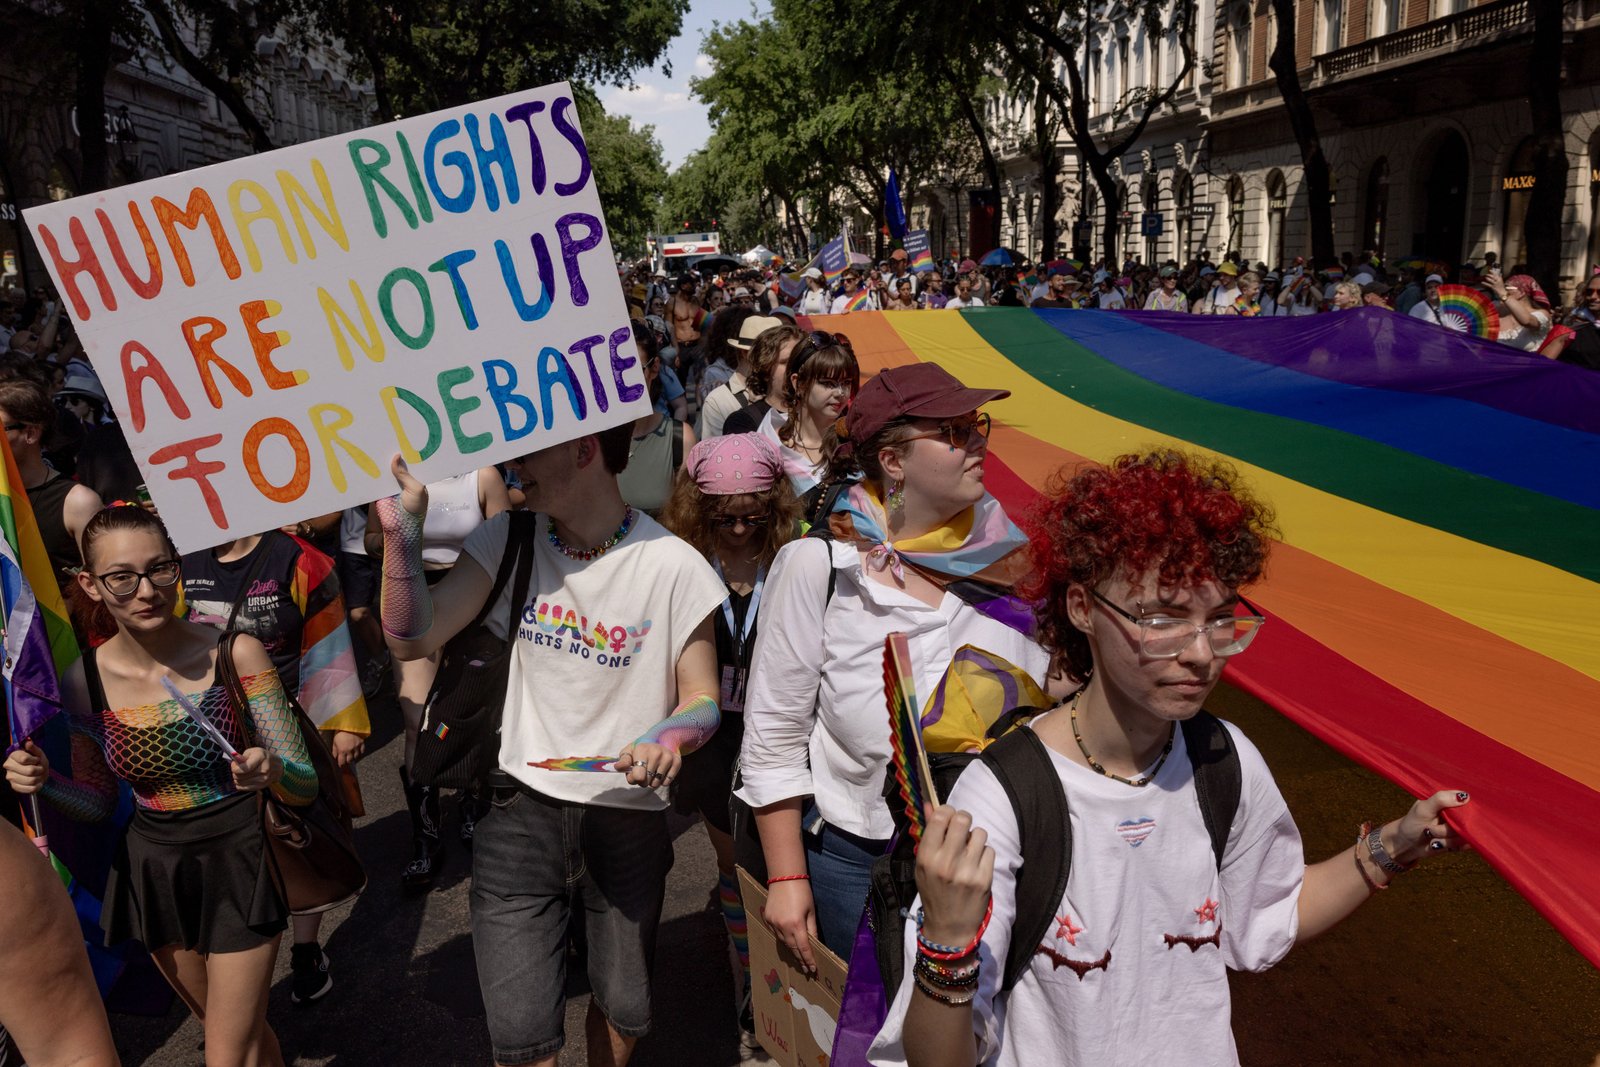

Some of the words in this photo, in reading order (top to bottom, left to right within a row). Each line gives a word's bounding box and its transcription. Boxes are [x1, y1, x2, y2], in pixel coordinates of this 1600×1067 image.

[38, 159, 349, 321] HUMAN
[349, 97, 591, 238] RIGHTS
[1146, 217, 1159, 234] P
[120, 300, 309, 432] ARE
[317, 249, 479, 371] NOT
[494, 213, 602, 322] UP
[148, 403, 380, 529] FOR
[380, 327, 645, 464] DEBATE
[248, 596, 278, 607] URBAN
[248, 602, 280, 612] CULTURE
[519, 627, 562, 650] HURTS
[569, 642, 590, 659] NO
[597, 653, 631, 668] ONE
